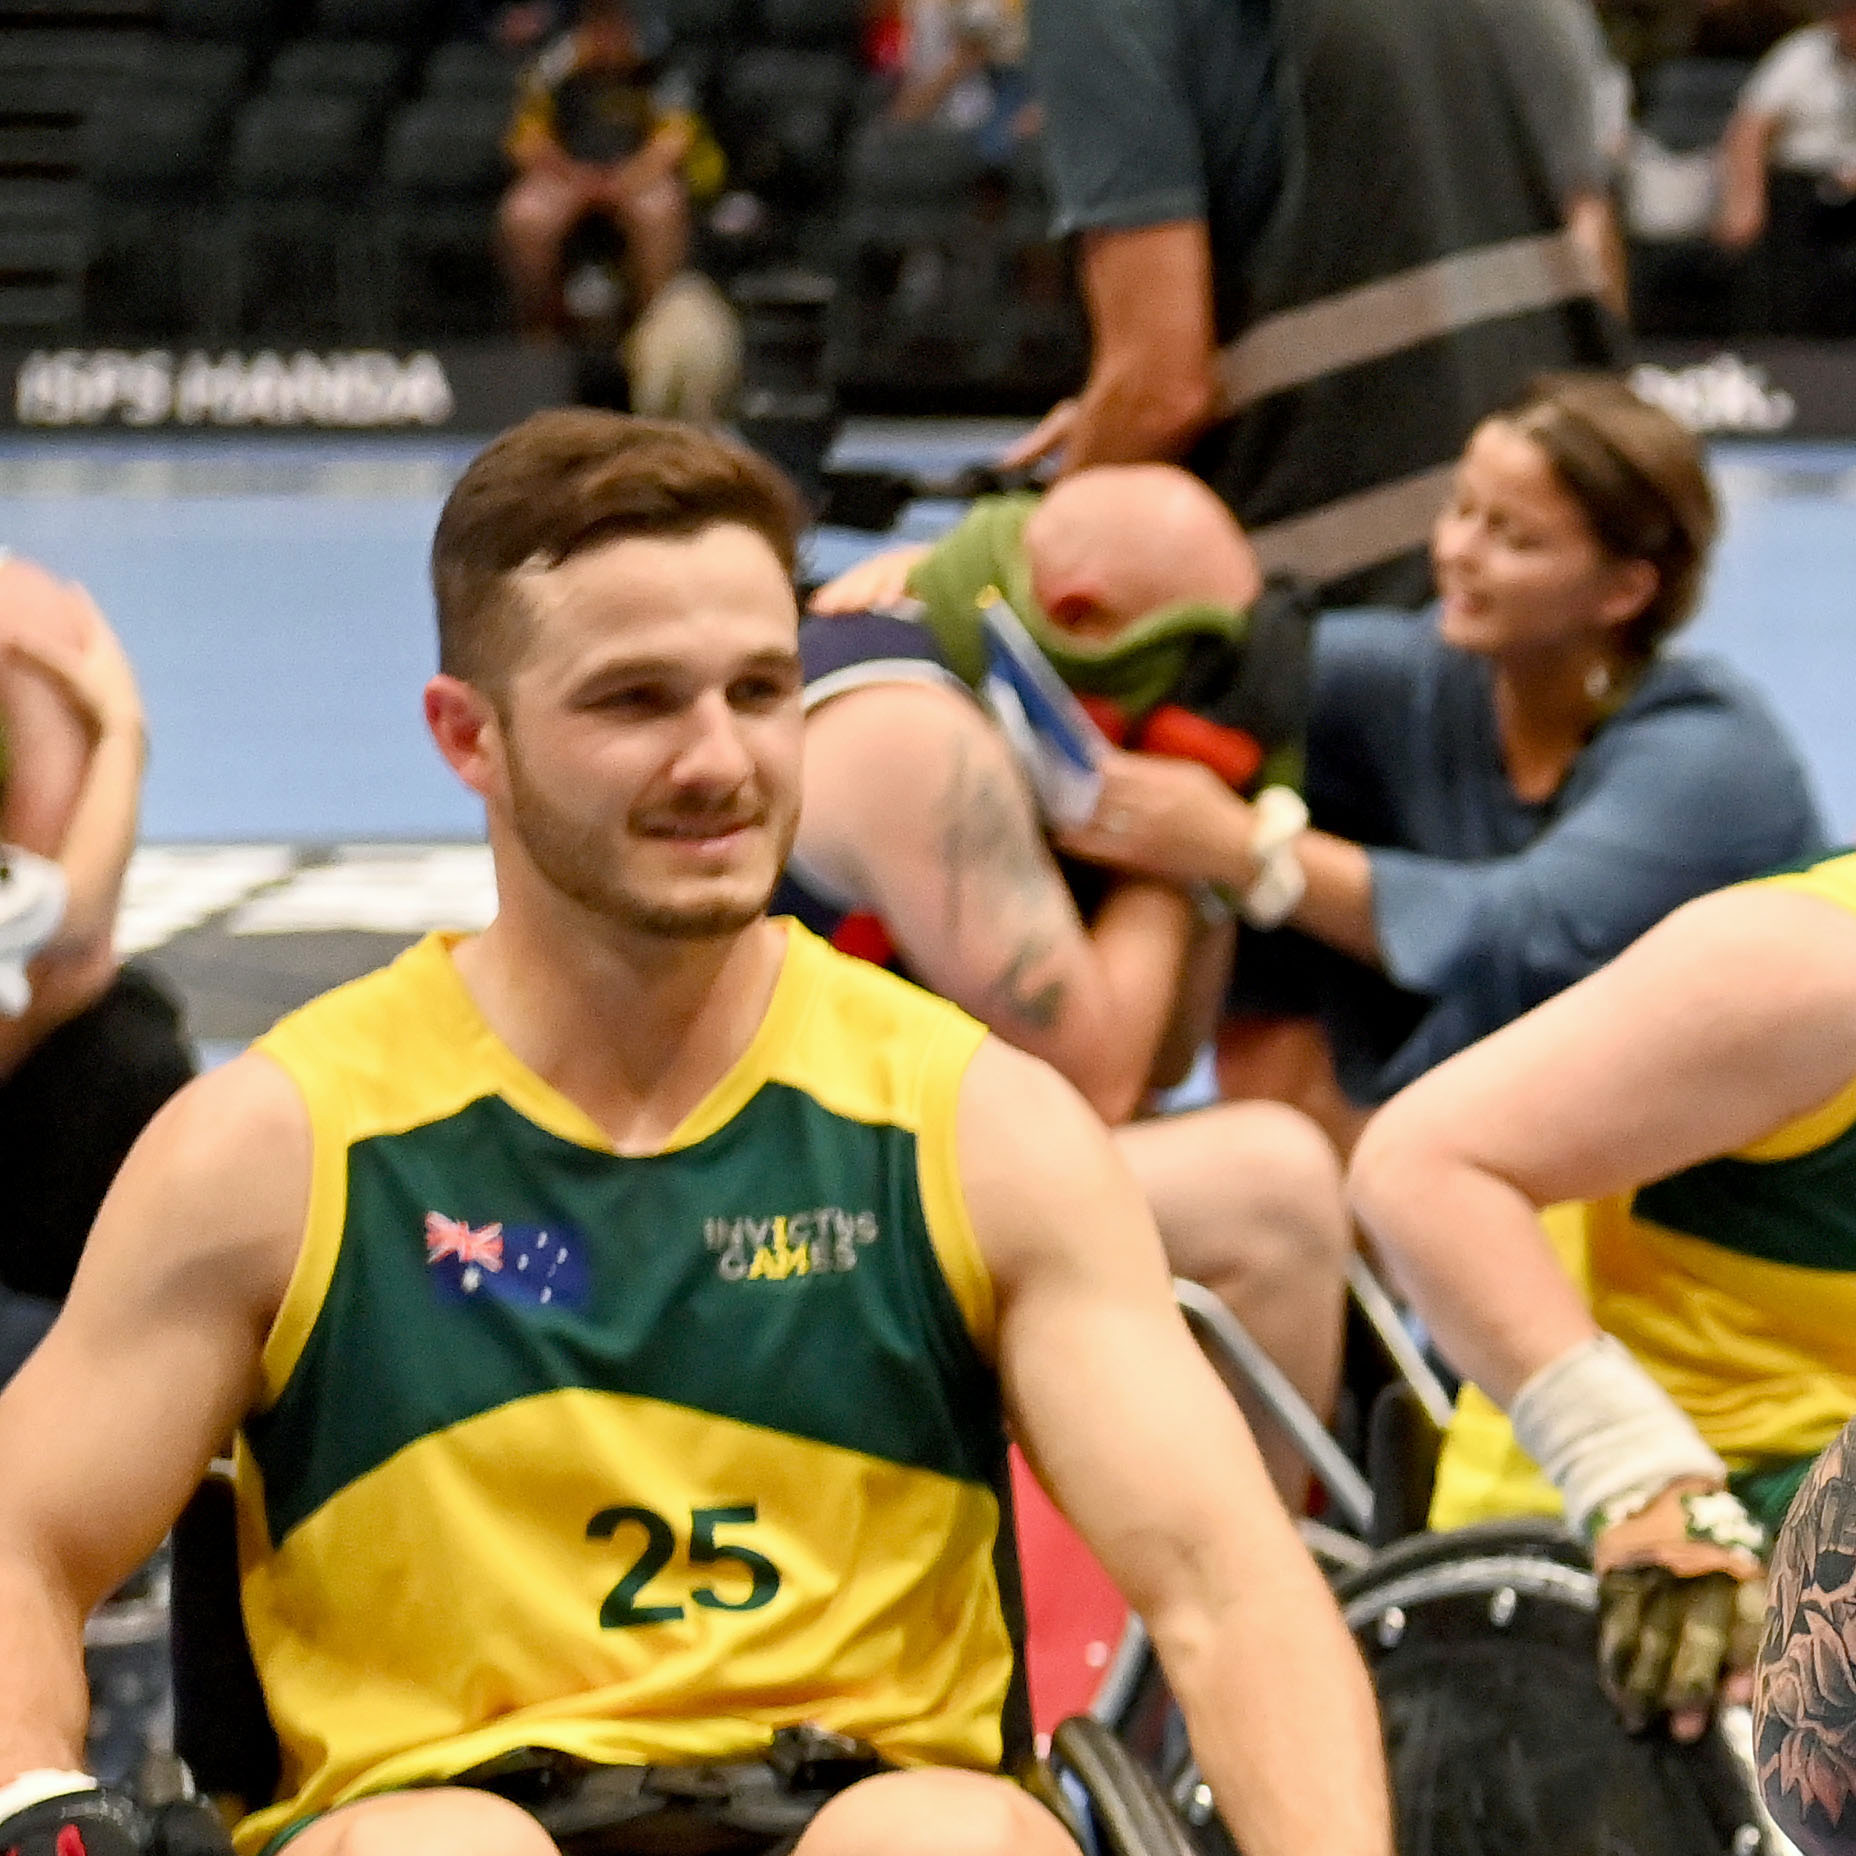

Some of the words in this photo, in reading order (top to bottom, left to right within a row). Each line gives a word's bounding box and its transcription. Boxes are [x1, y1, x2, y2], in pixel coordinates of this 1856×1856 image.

[15, 349, 174, 427] ISPS
[177, 349, 455, 427] HANDA
[586, 1505, 781, 1628] 25
